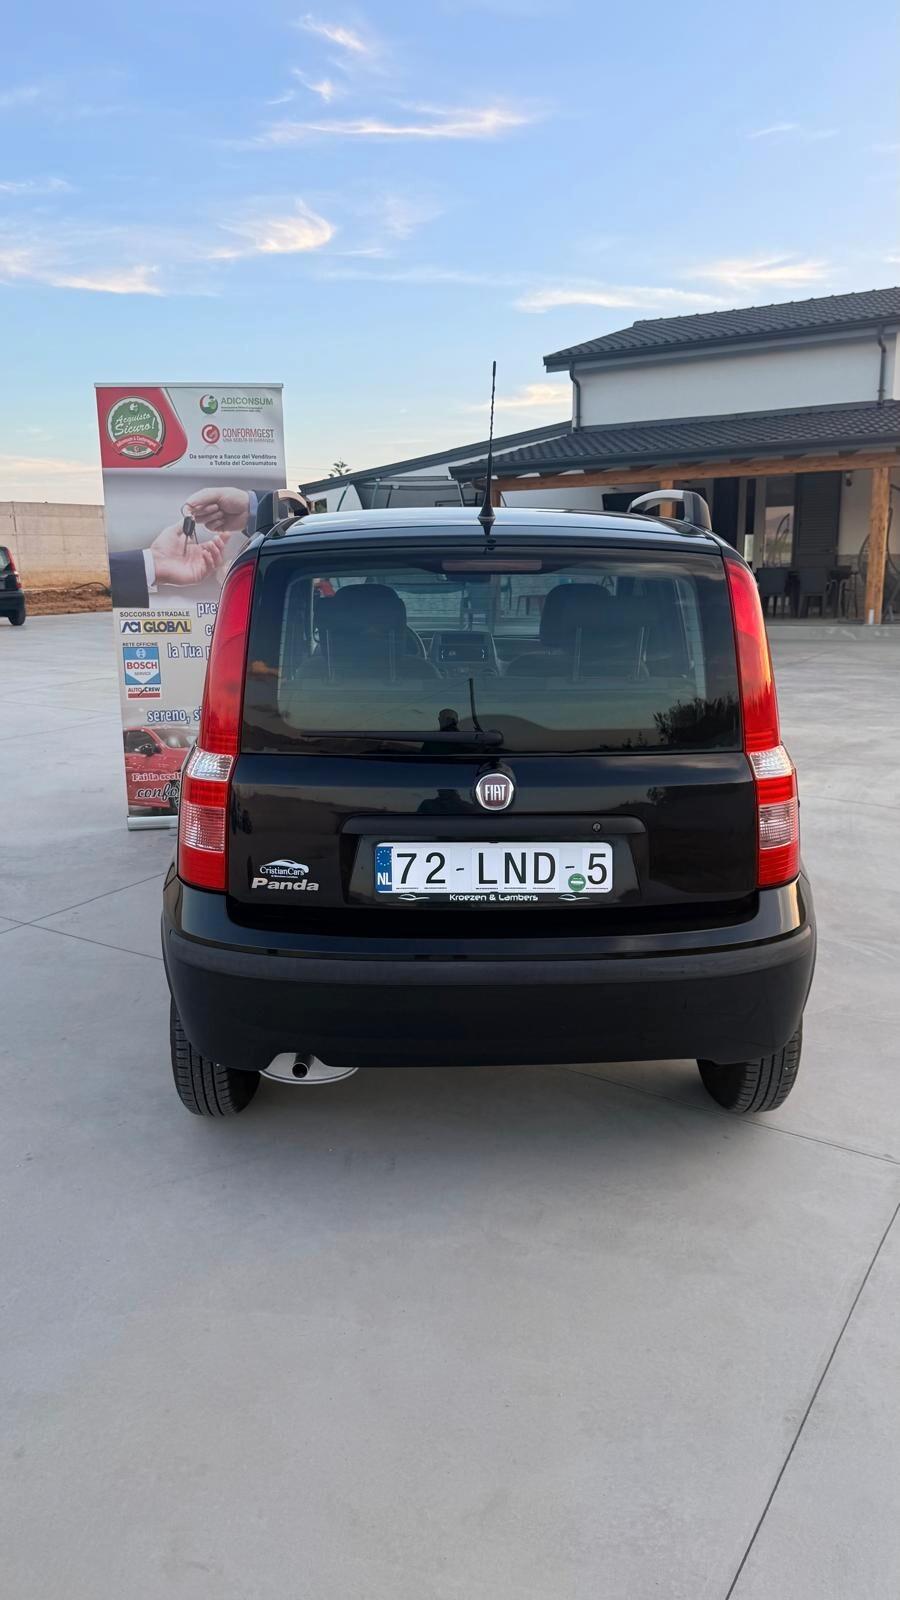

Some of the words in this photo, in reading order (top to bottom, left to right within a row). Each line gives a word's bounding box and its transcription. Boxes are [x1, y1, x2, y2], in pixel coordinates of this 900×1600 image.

[221, 397, 273, 405] ADICONSUM
[115, 413, 151, 425] Acquisto
[114, 417, 156, 436] Sicuro!
[222, 428, 275, 438] CONFORMGEST
[122, 621, 141, 633] ACI
[143, 621, 191, 633] GLOBAL
[167, 643, 179, 658] la
[181, 643, 203, 658] Tua
[147, 709, 190, 724] sereno,
[484, 784, 506, 801] FIAT
[251, 877, 320, 891] Panda
[377, 872, 392, 886] NL
